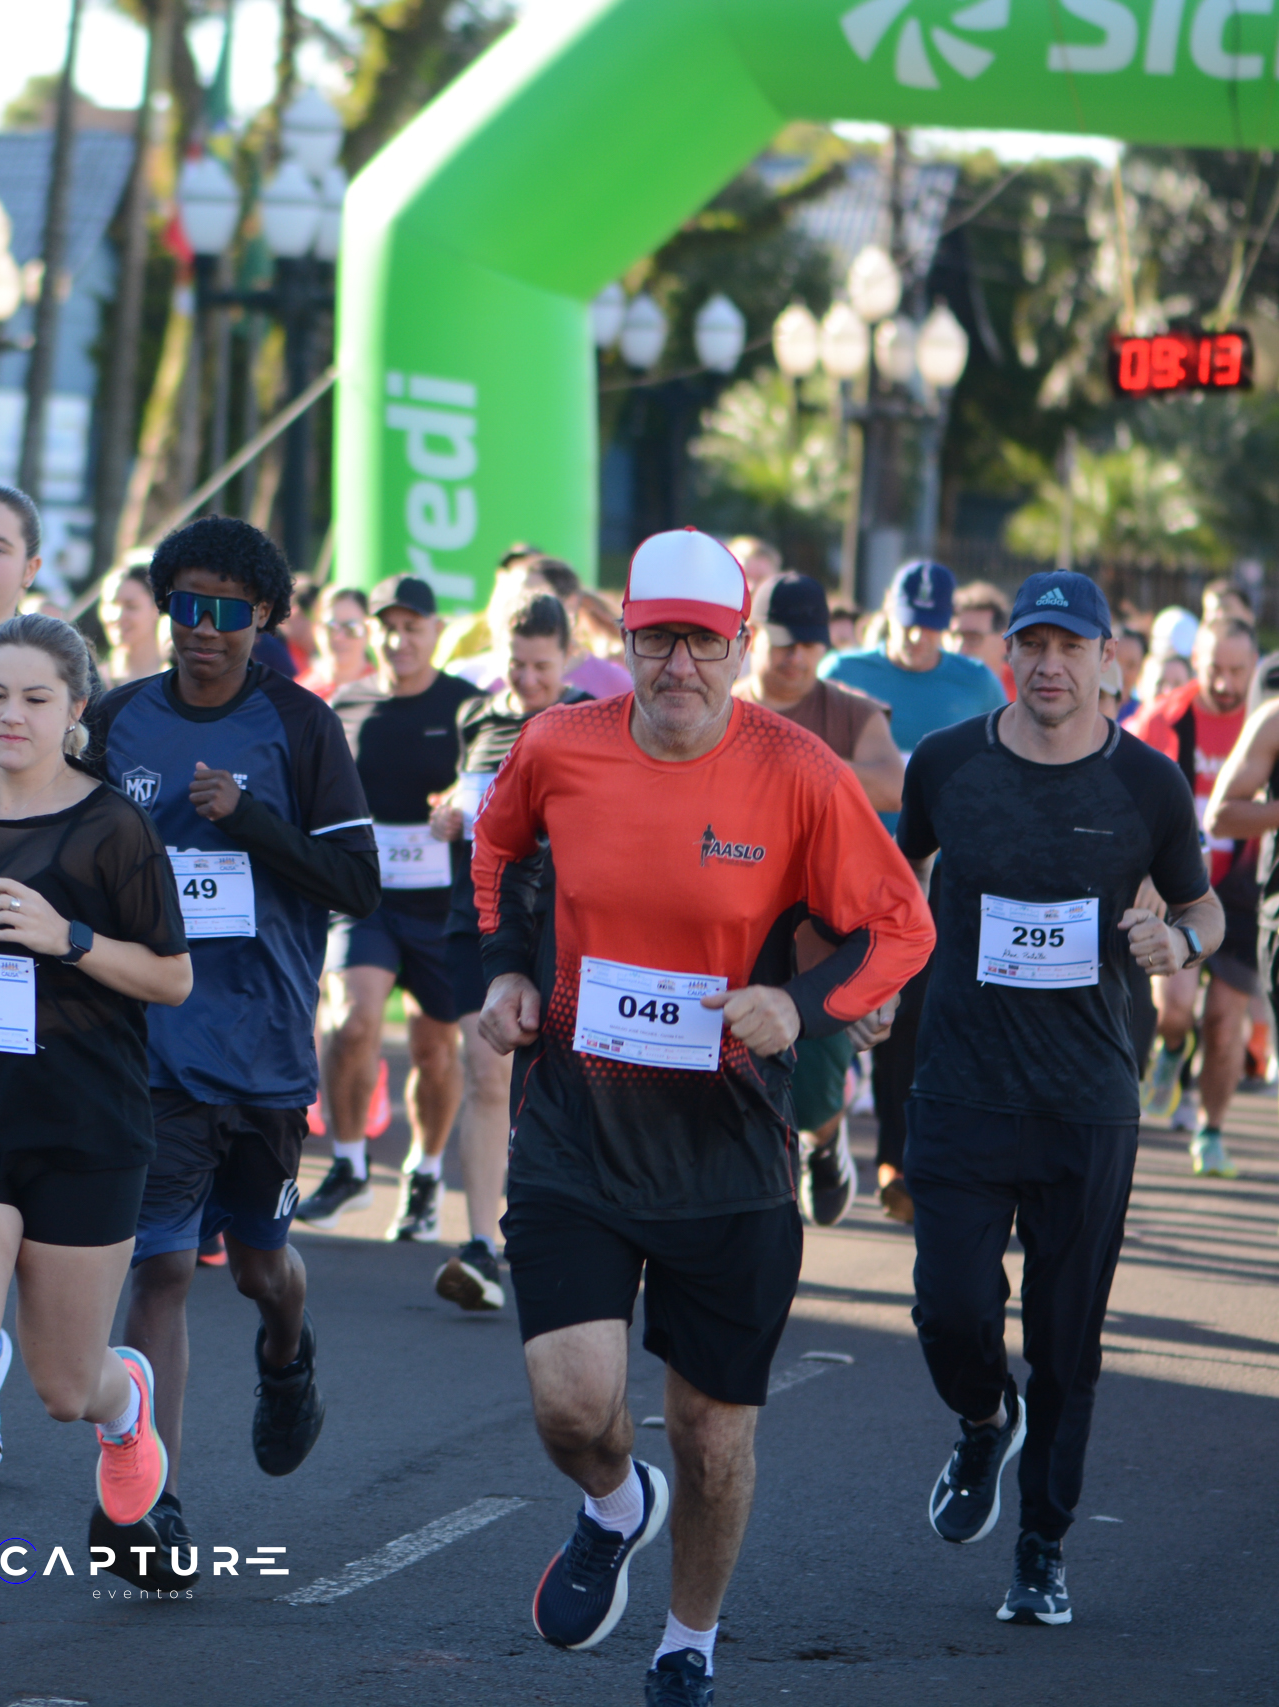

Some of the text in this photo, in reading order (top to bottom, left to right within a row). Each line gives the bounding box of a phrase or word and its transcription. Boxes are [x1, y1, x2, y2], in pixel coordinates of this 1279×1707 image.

[385, 370, 478, 617] redi
[1035, 598, 1069, 608] adidas
[126, 778, 156, 802] MKT
[388, 848, 424, 862] 292
[709, 839, 767, 863] AASLO
[1011, 926, 1064, 948] 295
[618, 995, 680, 1025] 048
